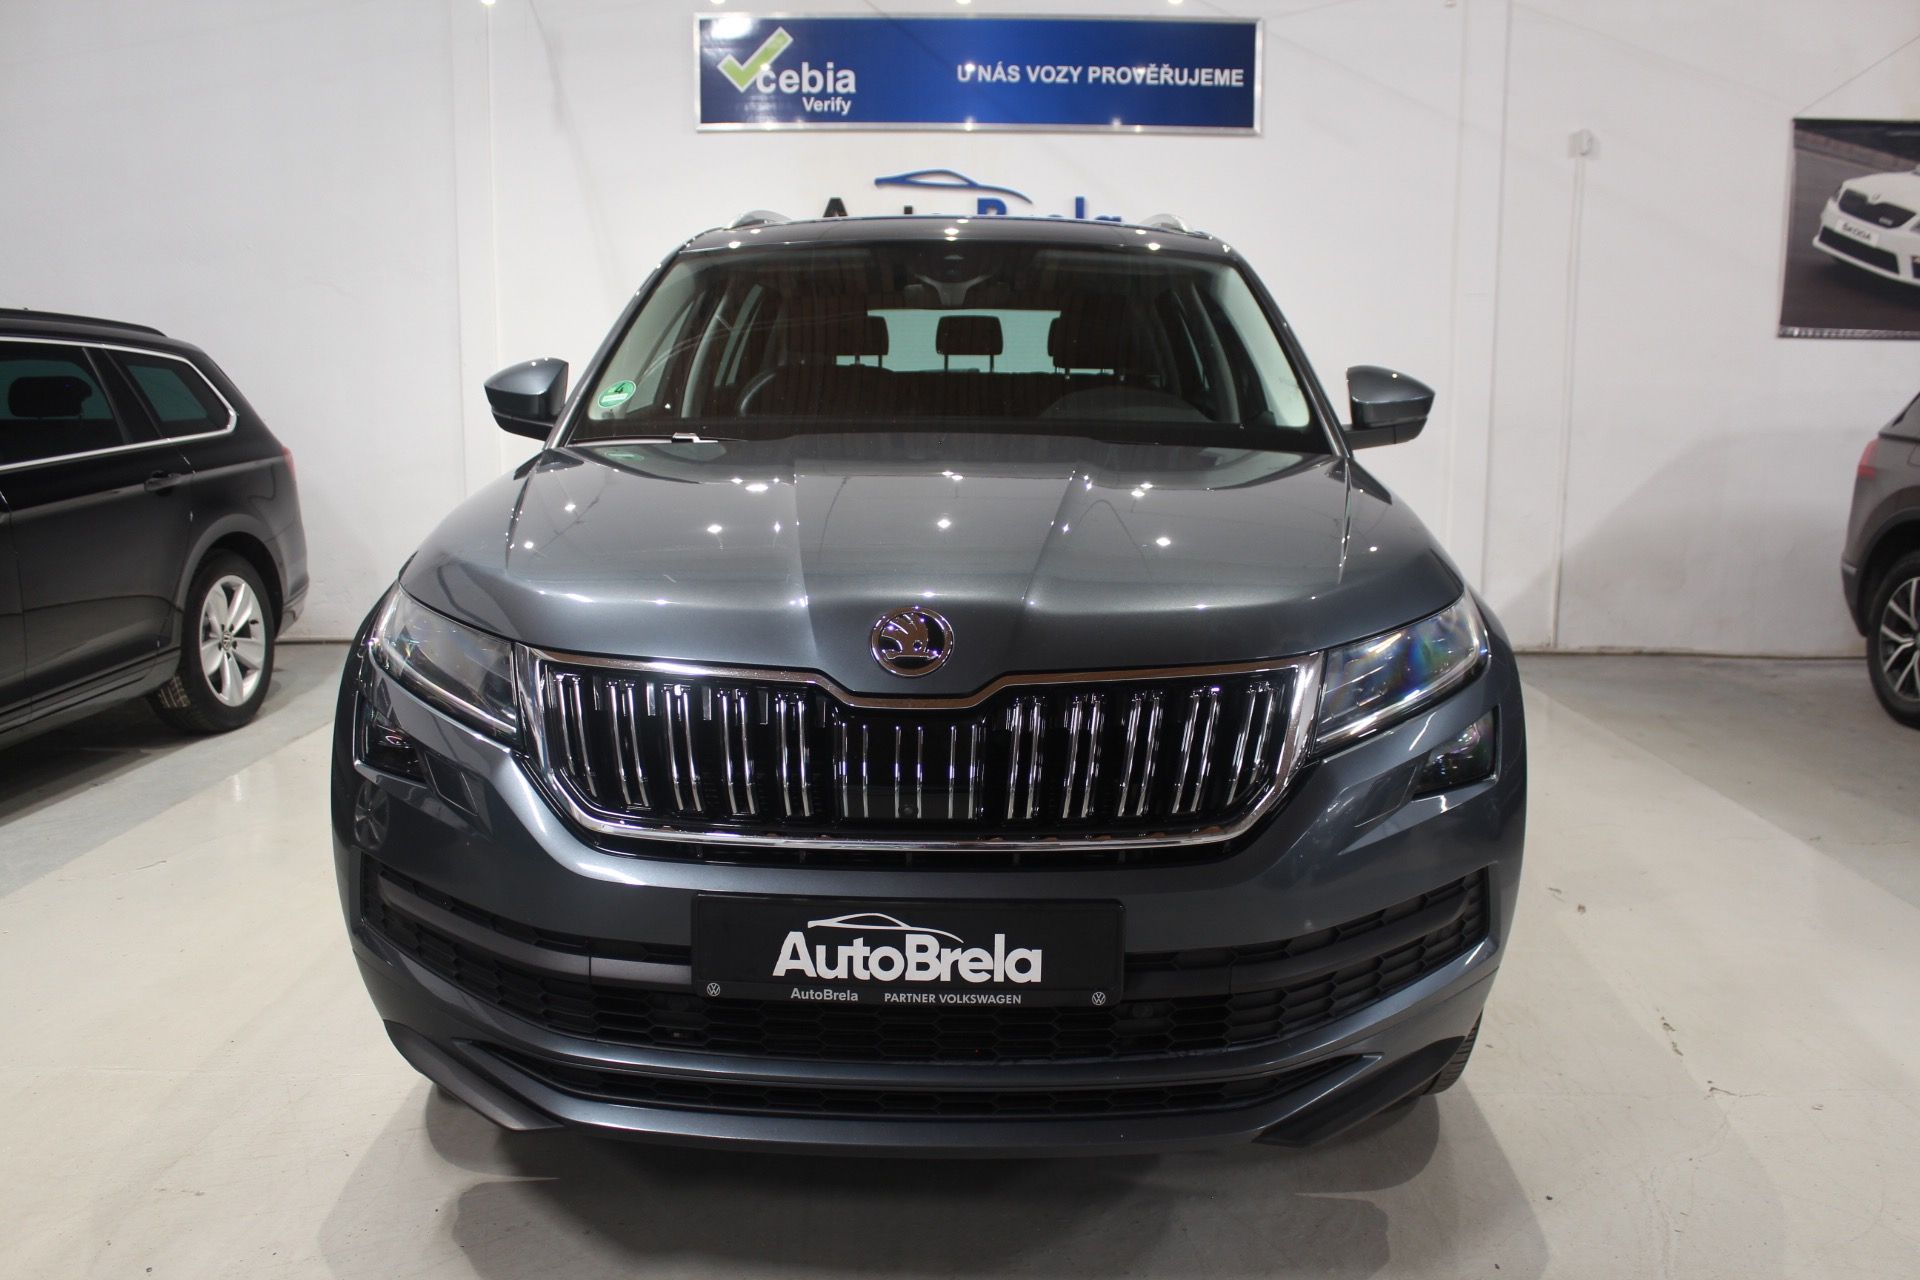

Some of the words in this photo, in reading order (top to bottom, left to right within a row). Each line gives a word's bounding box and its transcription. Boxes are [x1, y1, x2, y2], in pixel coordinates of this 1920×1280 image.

[756, 62, 857, 94] cebia
[957, 64, 973, 82] U
[978, 61, 1020, 82] NÁS
[1026, 65, 1082, 84] VOZY
[1088, 63, 1244, 88] PROVĚŘUJEME
[802, 96, 852, 116] Verify
[772, 930, 1043, 984] AutoBrela
[790, 987, 859, 1002] AutoBrela
[884, 992, 936, 1004] PARTNER
[938, 992, 1022, 1005] VOLKSWAGEN
